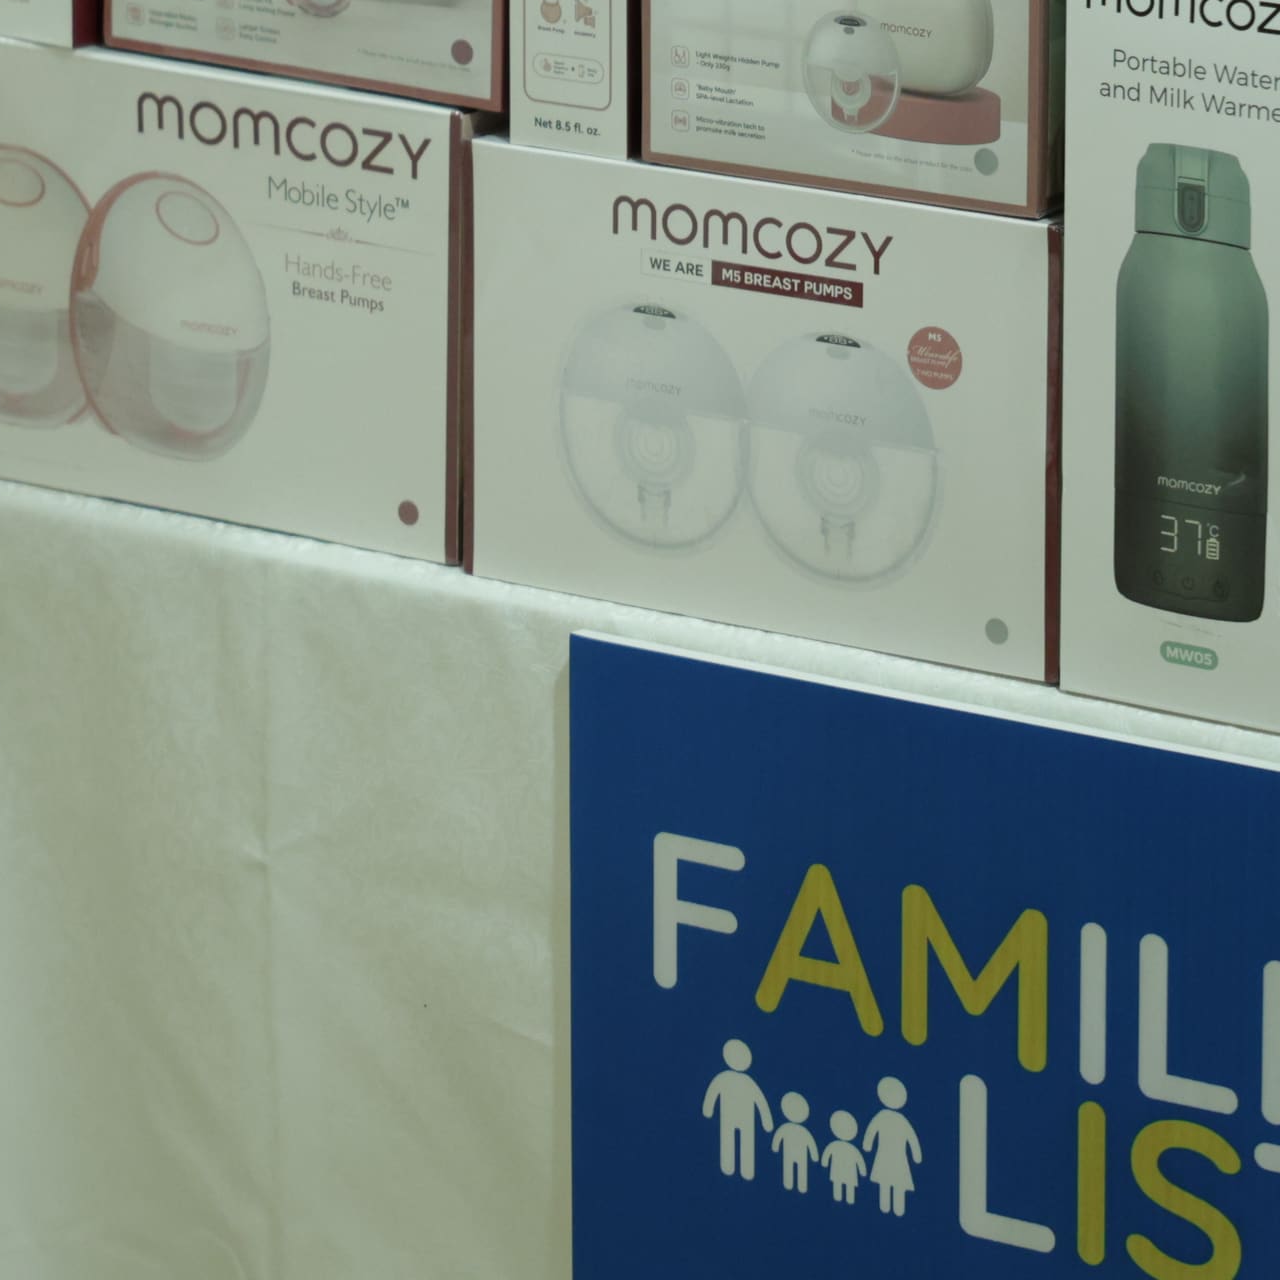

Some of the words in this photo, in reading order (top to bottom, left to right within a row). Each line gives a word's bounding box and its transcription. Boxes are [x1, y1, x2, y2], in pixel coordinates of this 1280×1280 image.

[1113, 48, 1207, 81] Portable
[1099, 80, 1141, 102] and
[1149, 85, 1195, 111] Milk
[534, 117, 553, 129] Net
[555, 119, 572, 132] 8.5
[587, 126, 601, 136] oz.
[267, 175, 339, 212] Mobile
[284, 252, 393, 292] Hands-Free
[648, 255, 672, 273] WE
[675, 259, 705, 278] ARE
[721, 267, 742, 283] M5
[743, 270, 800, 294] BREAST
[804, 281, 853, 302] PUMPS
[292, 280, 336, 305] Breast
[340, 288, 385, 313] Pumps
[1160, 514, 1202, 556] 37
[1166, 645, 1213, 666] MW05
